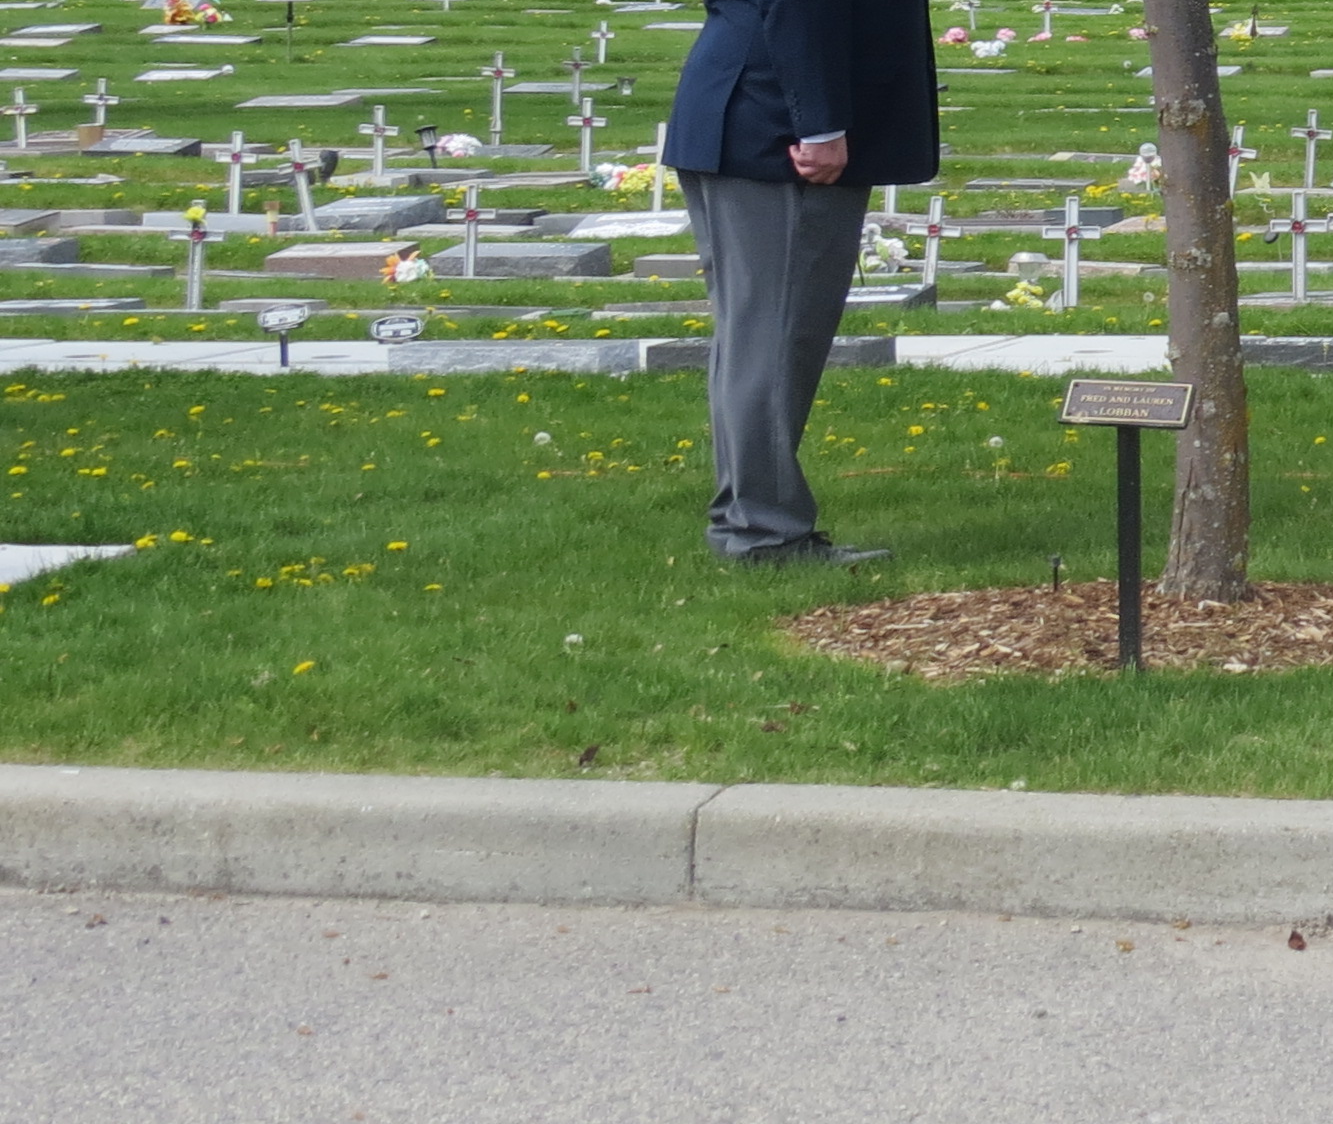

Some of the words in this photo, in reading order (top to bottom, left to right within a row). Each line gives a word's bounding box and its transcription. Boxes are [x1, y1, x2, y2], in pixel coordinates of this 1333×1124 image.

[1080, 394, 1107, 403] FRED
[1108, 395, 1131, 404] AND
[1133, 396, 1174, 406] LAUREN
[1098, 407, 1149, 417] LOBBAN
